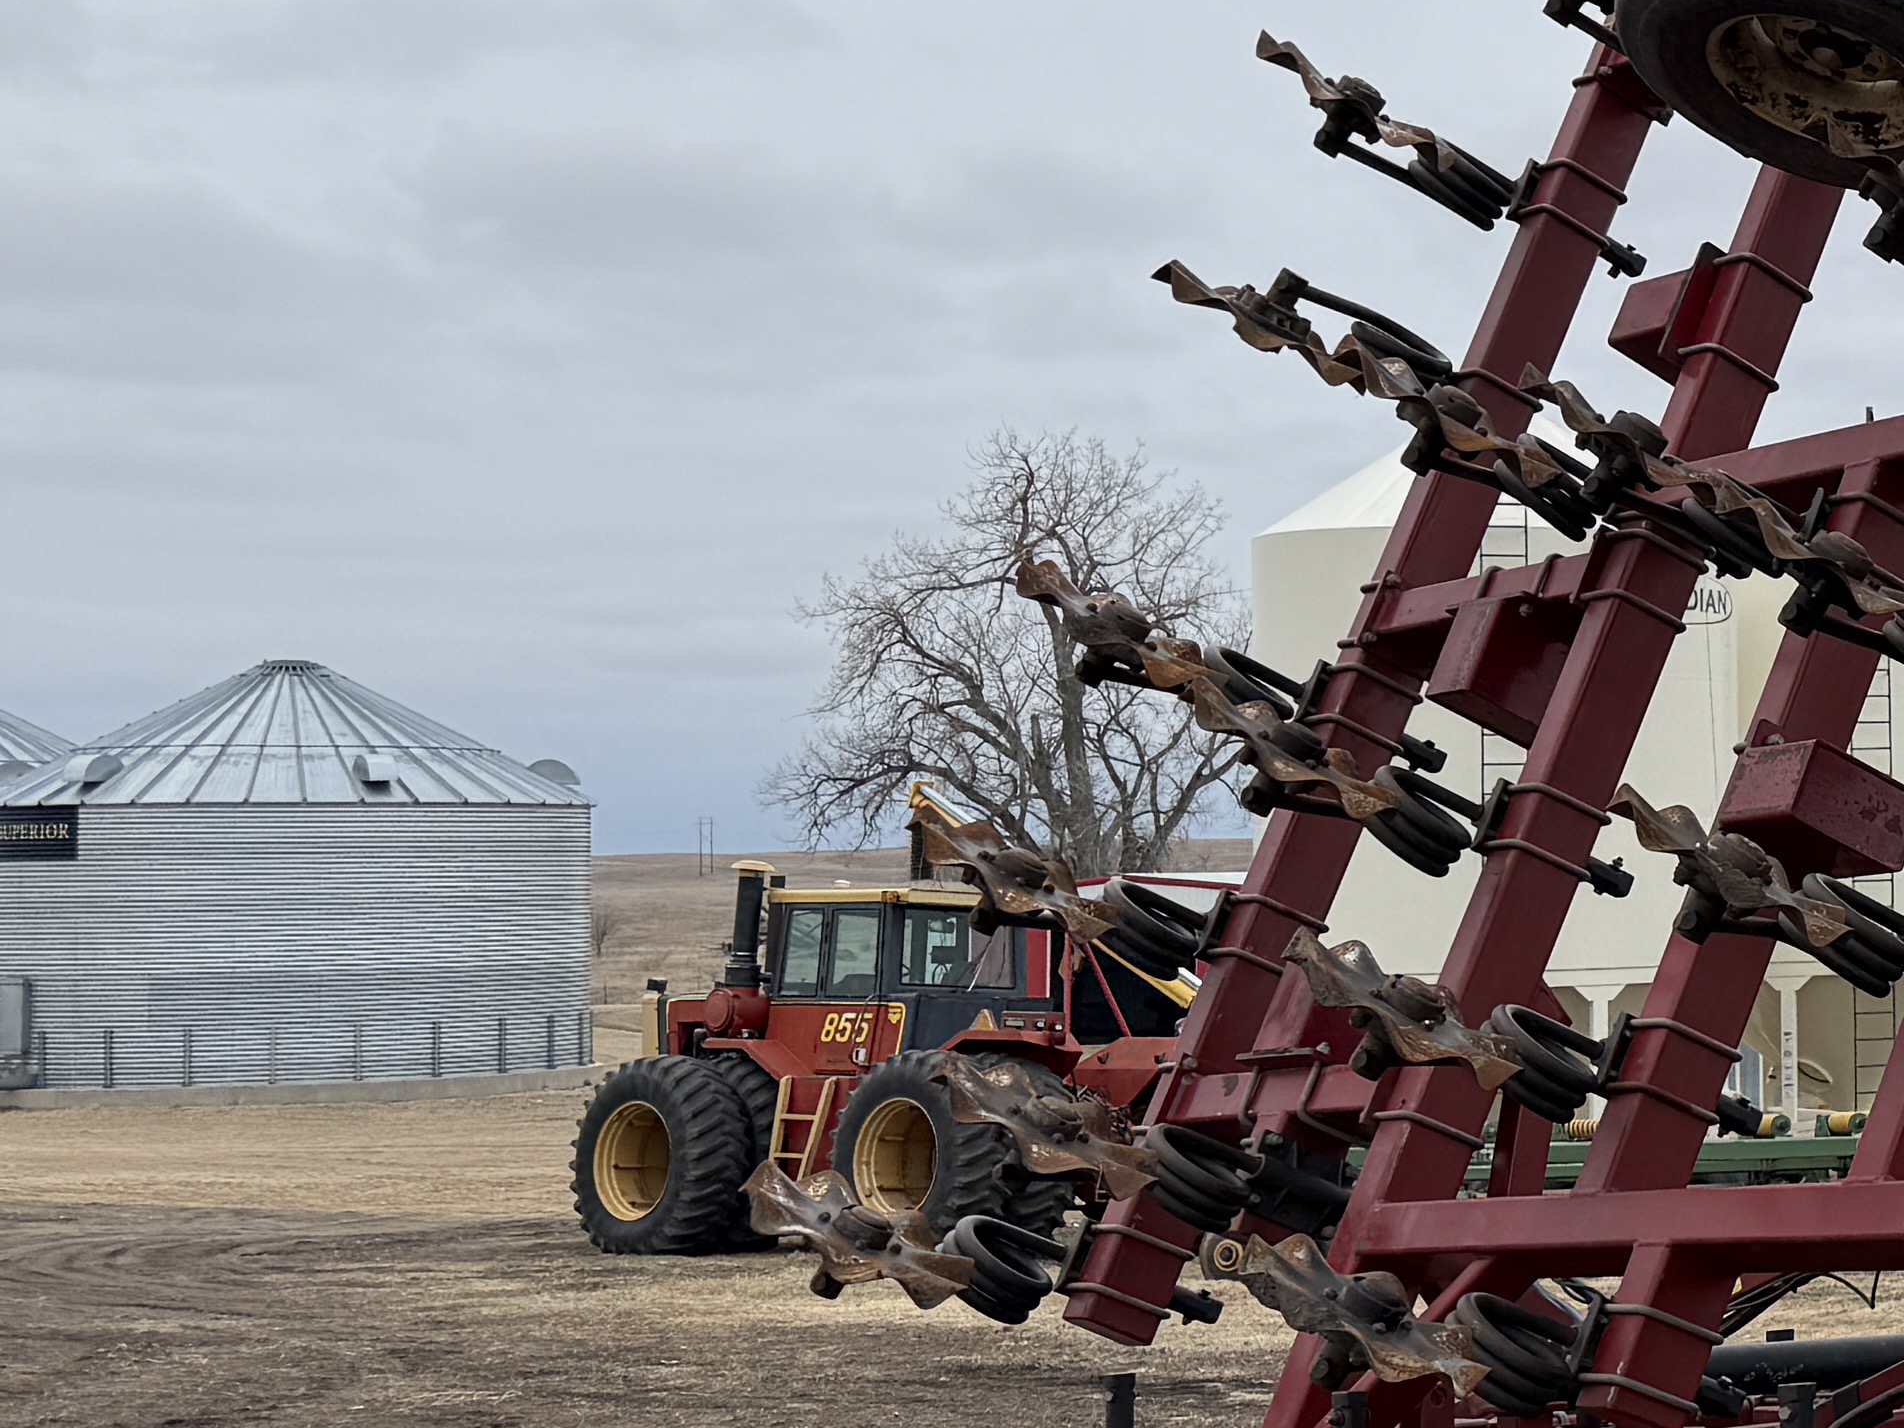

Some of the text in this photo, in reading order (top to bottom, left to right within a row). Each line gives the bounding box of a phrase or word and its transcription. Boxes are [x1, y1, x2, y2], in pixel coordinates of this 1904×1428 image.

[1687, 588, 1727, 615] DIAN
[0, 823, 69, 840] UPERIOR
[821, 1013, 874, 1042] 855
